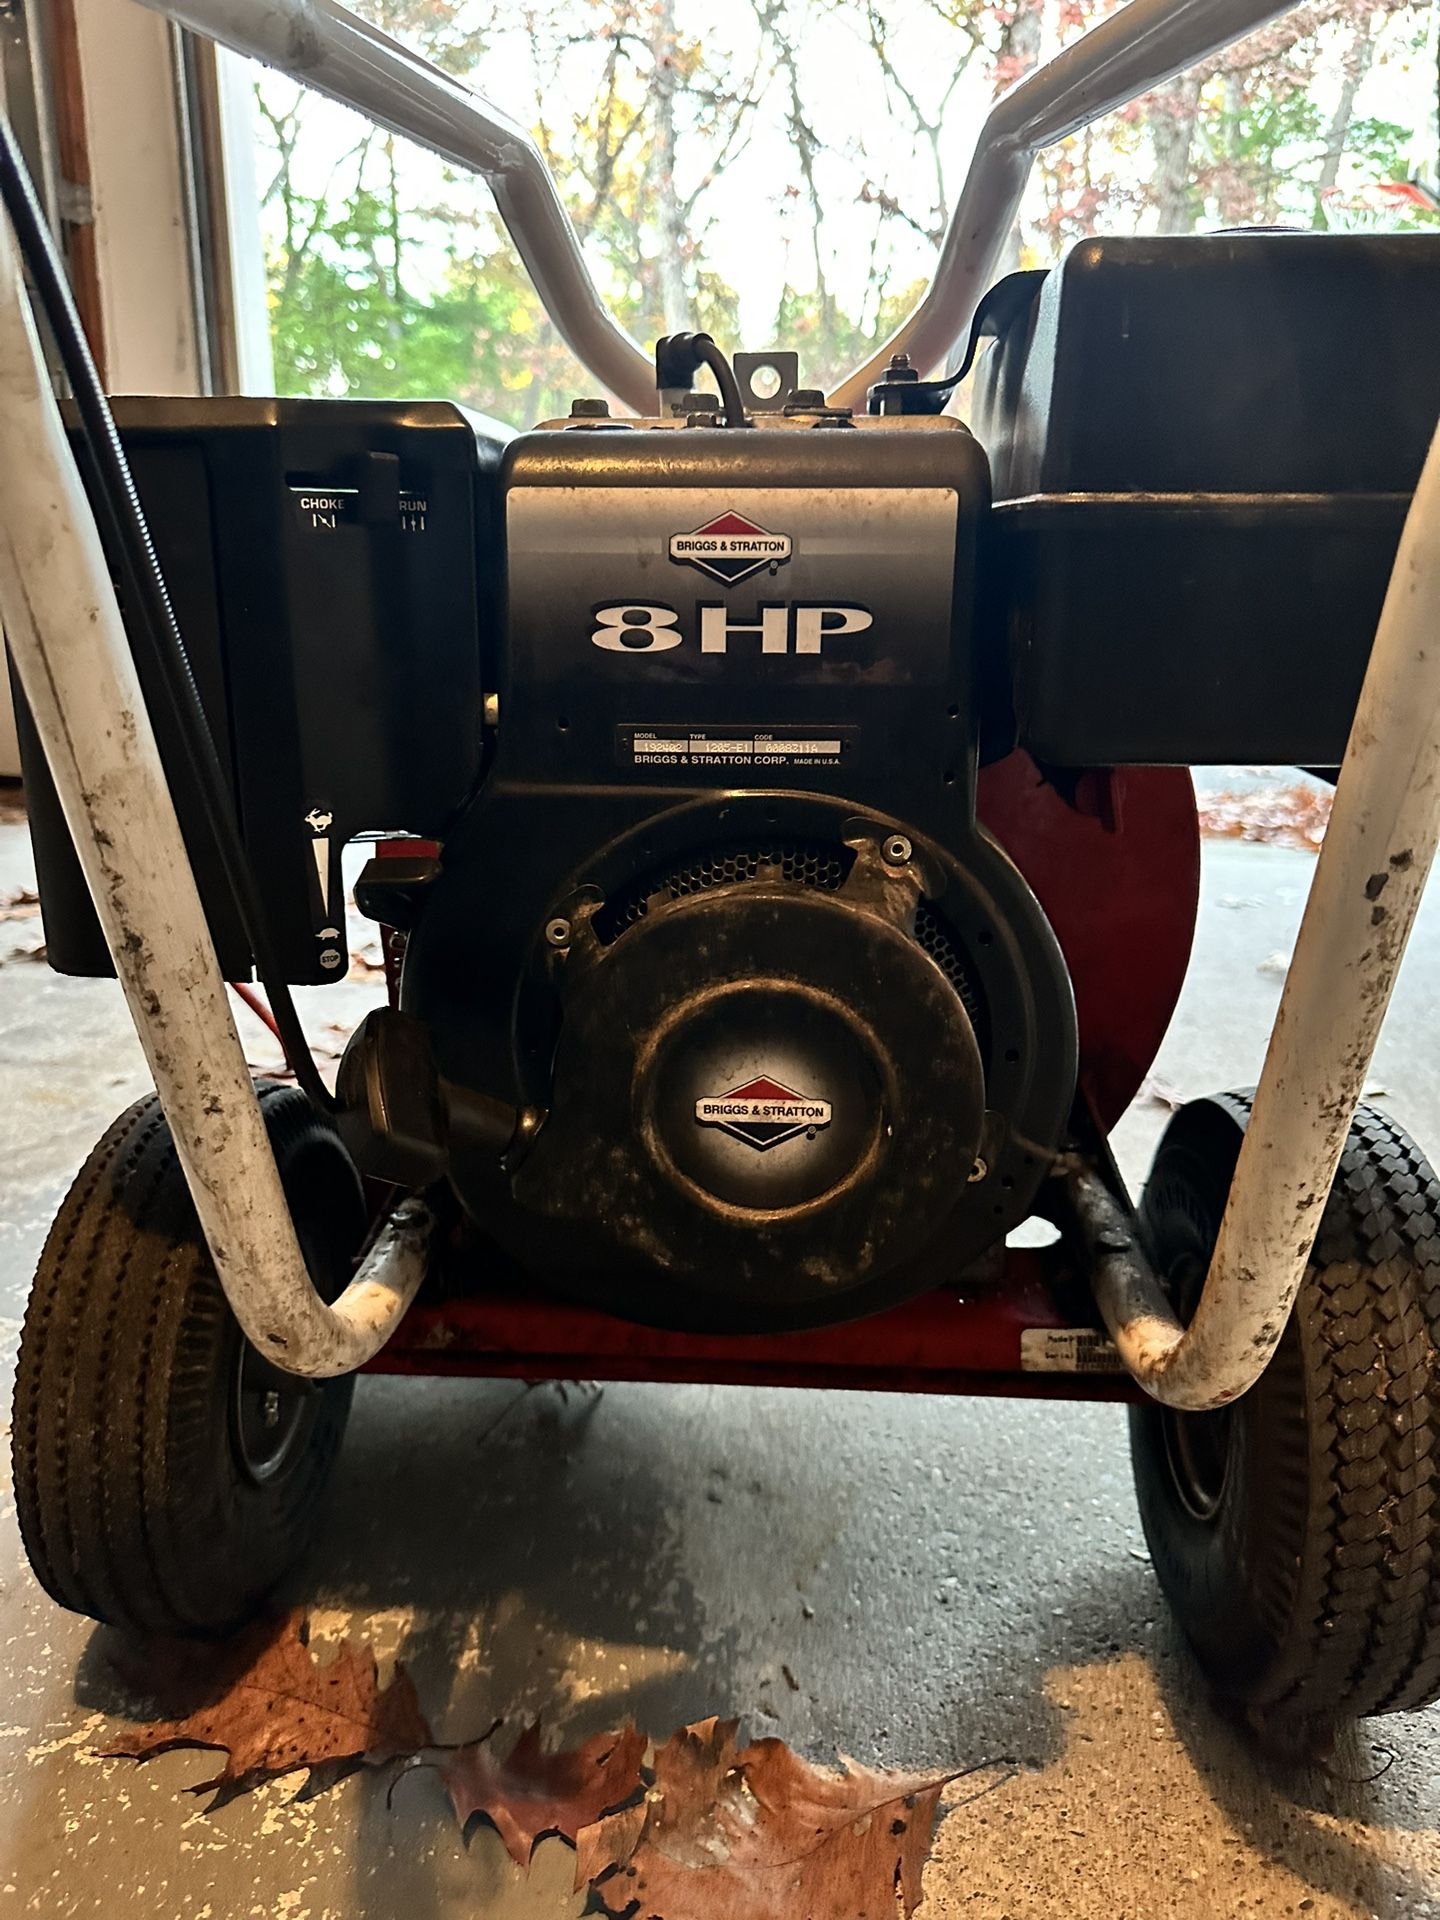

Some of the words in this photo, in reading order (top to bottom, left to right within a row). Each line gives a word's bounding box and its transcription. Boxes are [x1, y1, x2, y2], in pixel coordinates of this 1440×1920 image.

[300, 498, 345, 509] CHOKE
[399, 500, 427, 512] RUN
[676, 541, 717, 551] BRIGGS
[720, 541, 728, 551] &
[730, 541, 785, 552] STRATTON
[634, 755, 678, 764] BRIGGS
[680, 755, 689, 764] &
[691, 755, 751, 765] STRATTON
[754, 756, 790, 765] CORP.
[703, 1104, 749, 1115] BRIGGS
[751, 1105, 761, 1116] &
[763, 1106, 824, 1117] STRATTON
